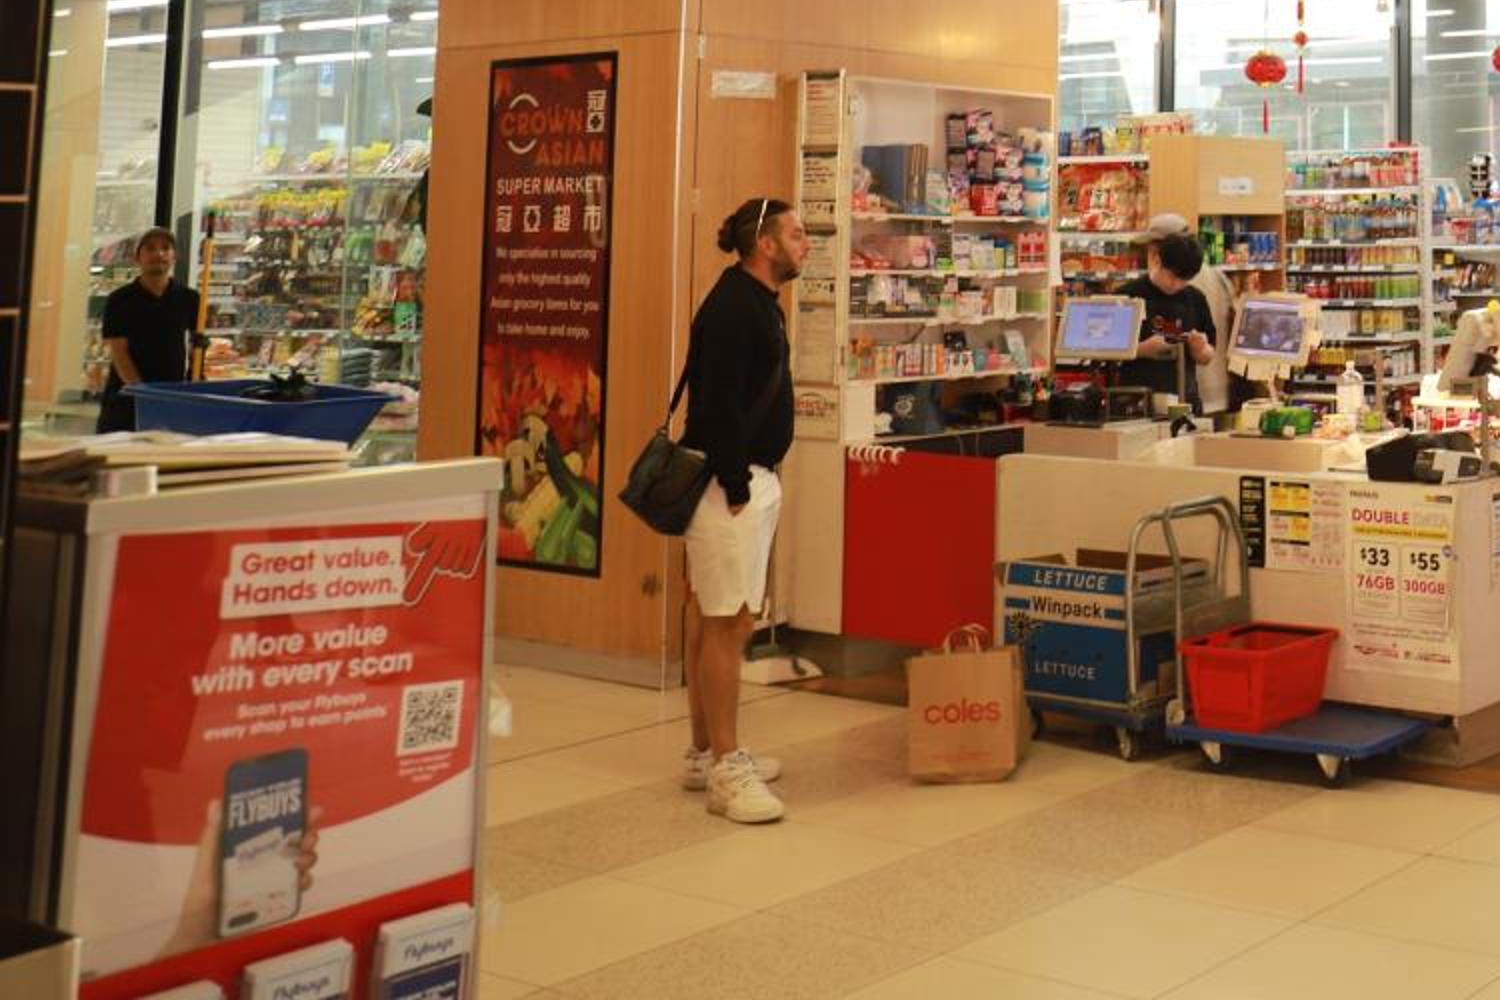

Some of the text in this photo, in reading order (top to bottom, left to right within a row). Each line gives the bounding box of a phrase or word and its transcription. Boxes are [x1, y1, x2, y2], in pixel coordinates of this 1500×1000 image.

[501, 104, 584, 137] CROWN
[536, 138, 604, 166] ASIAN
[496, 175, 602, 195] SUPER MARKET
[570, 298, 583, 310] for
[1351, 508, 1409, 524] DOUBLE
[241, 547, 396, 574] Great value.
[1360, 547, 1440, 572] $33 $55
[233, 576, 399, 604] Hands down.
[1034, 569, 1108, 591] LETTUCE
[1356, 574, 1446, 595] 76GB 300GB
[1031, 596, 1103, 618] Winpack
[229, 623, 388, 659] More value
[192, 652, 414, 695] with every scan
[1035, 660, 1096, 680] LETTUCE
[238, 702, 277, 718] Scan
[279, 700, 311, 714] your
[924, 698, 1001, 725] coles
[203, 726, 246, 741] every
[249, 719, 287, 735] shop
[290, 716, 305, 728] to
[308, 713, 341, 726] earn
[229, 790, 300, 829] FLYBUYS
